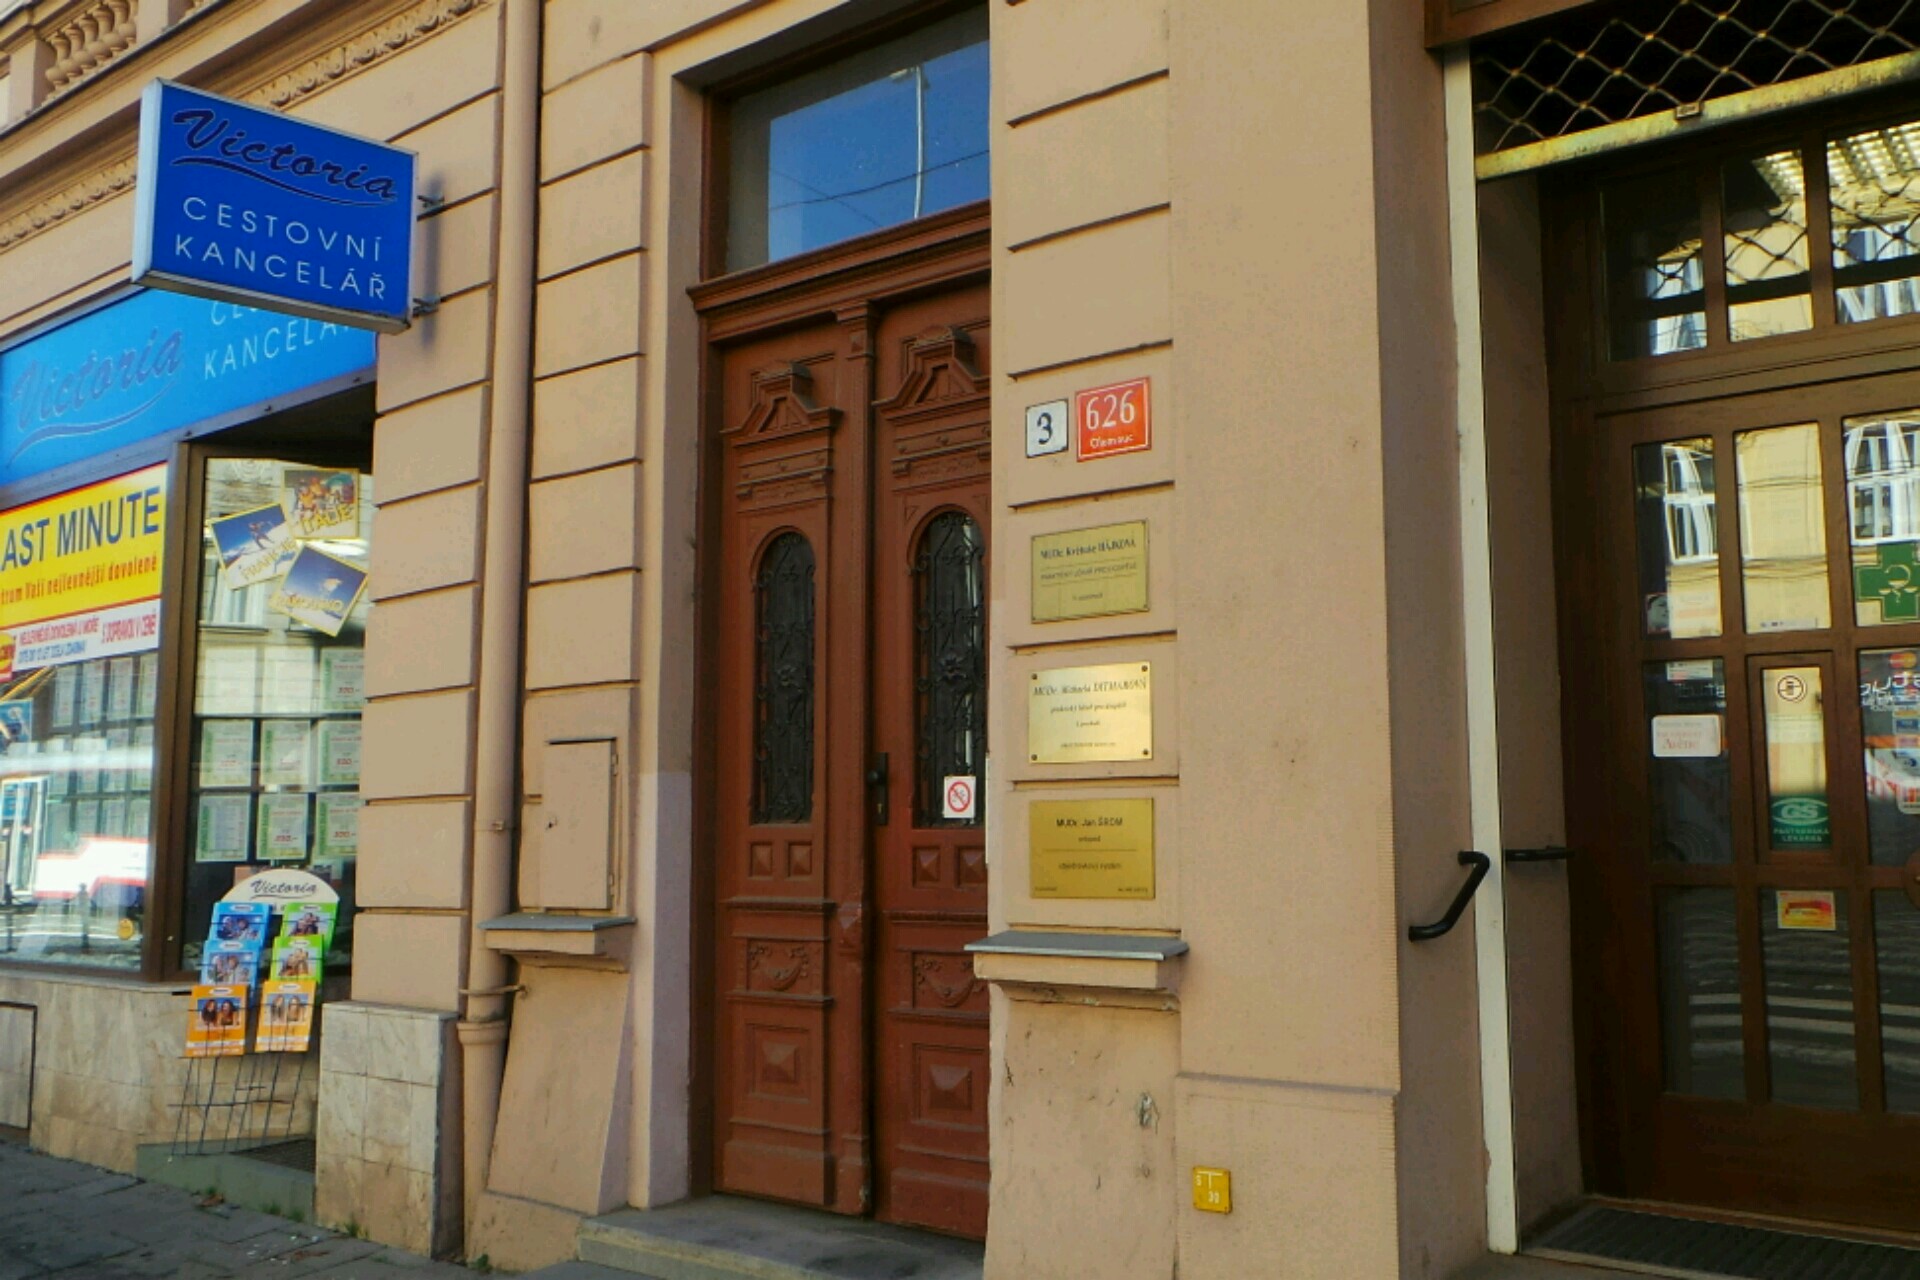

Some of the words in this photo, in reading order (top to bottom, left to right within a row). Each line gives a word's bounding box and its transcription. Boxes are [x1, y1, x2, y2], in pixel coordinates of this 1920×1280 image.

[172, 108, 398, 200] Victoria
[183, 197, 382, 261] CESTOVNÍ
[175, 234, 386, 299] KANCELÁŘ
[11, 327, 184, 432] Victoria
[1037, 412, 1053, 445] 3
[1086, 390, 1135, 430] 626
[1090, 434, 1134, 449] Olomouc
[57, 485, 162, 558] MINUTE
[108, 552, 157, 581] dovolené
[251, 878, 318, 895] Victoria
